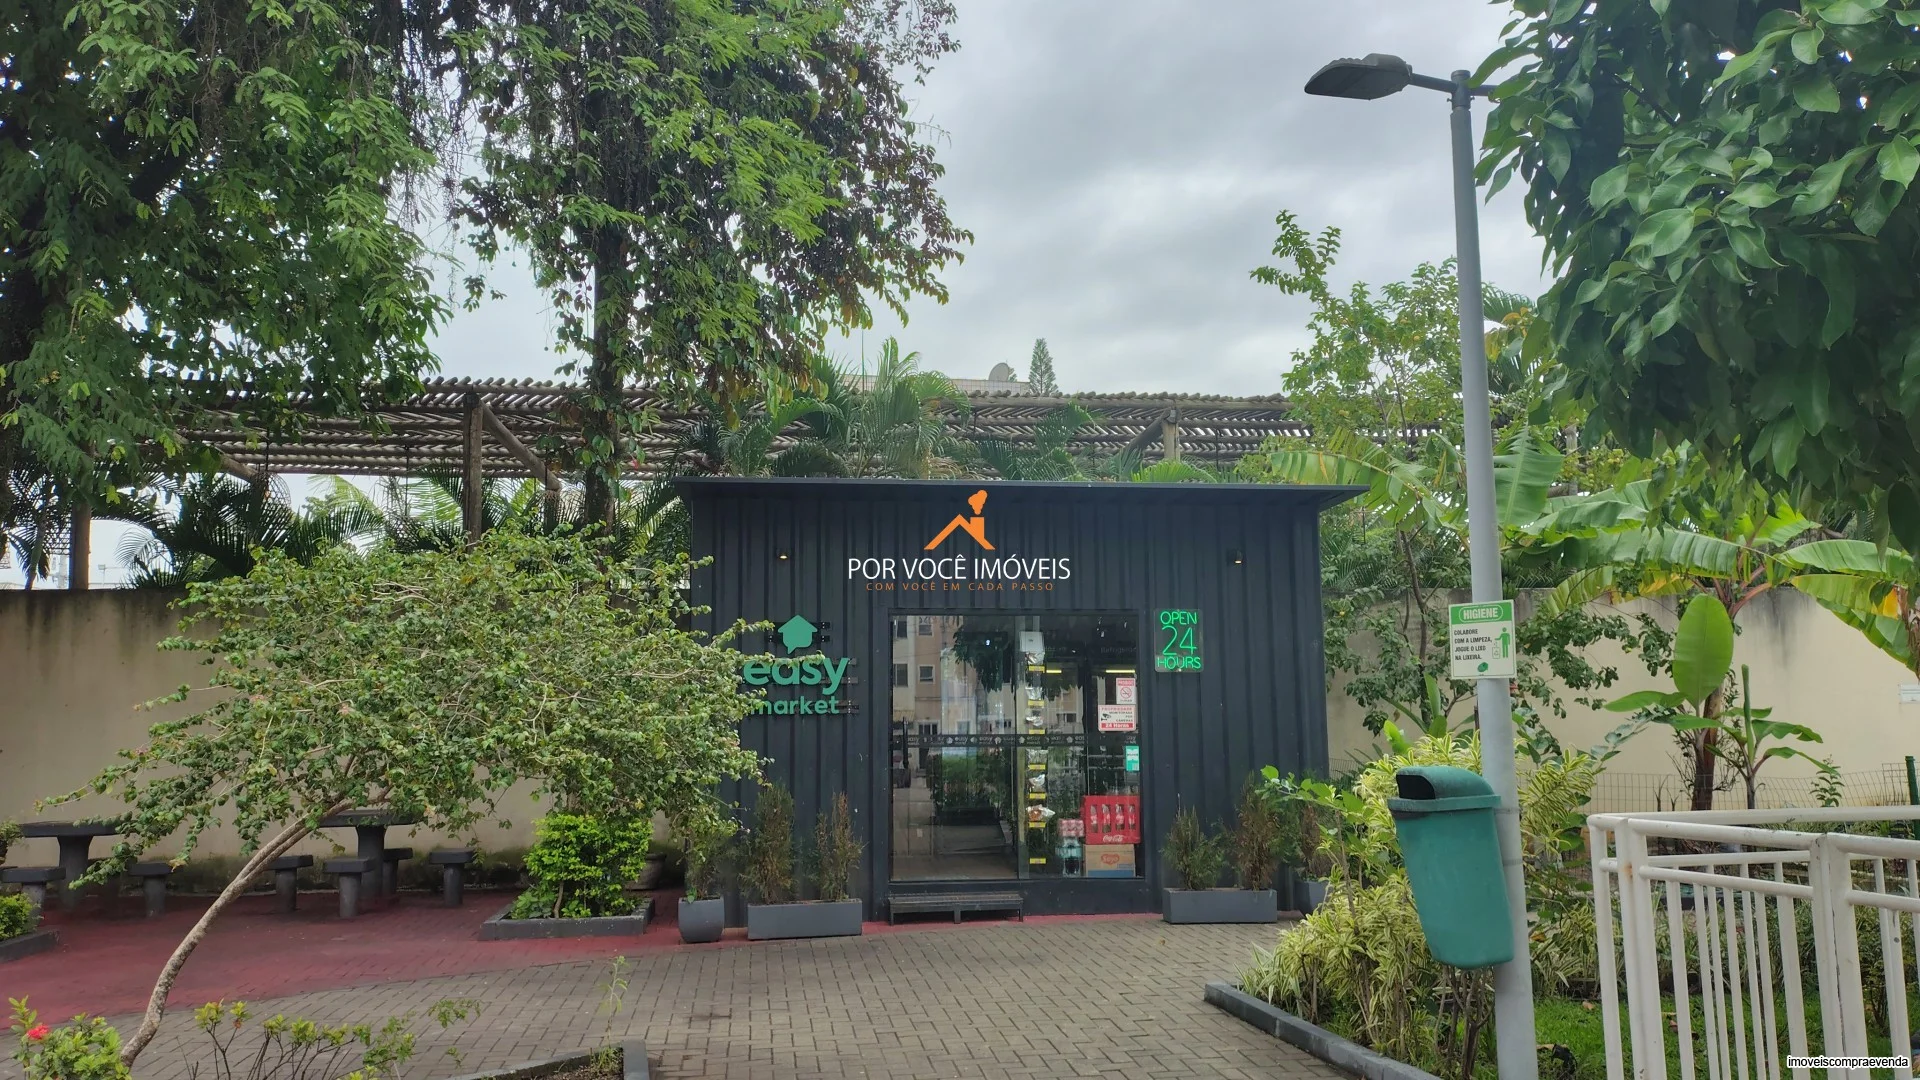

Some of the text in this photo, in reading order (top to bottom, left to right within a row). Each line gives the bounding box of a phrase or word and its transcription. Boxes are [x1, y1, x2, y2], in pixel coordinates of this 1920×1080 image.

[1160, 611, 1198, 625] OPEN
[1463, 607, 1499, 620] HIGIENE
[1161, 625, 1198, 656] 24
[1157, 656, 1202, 670] HOURS
[743, 656, 849, 696] easy
[749, 695, 841, 715] market
